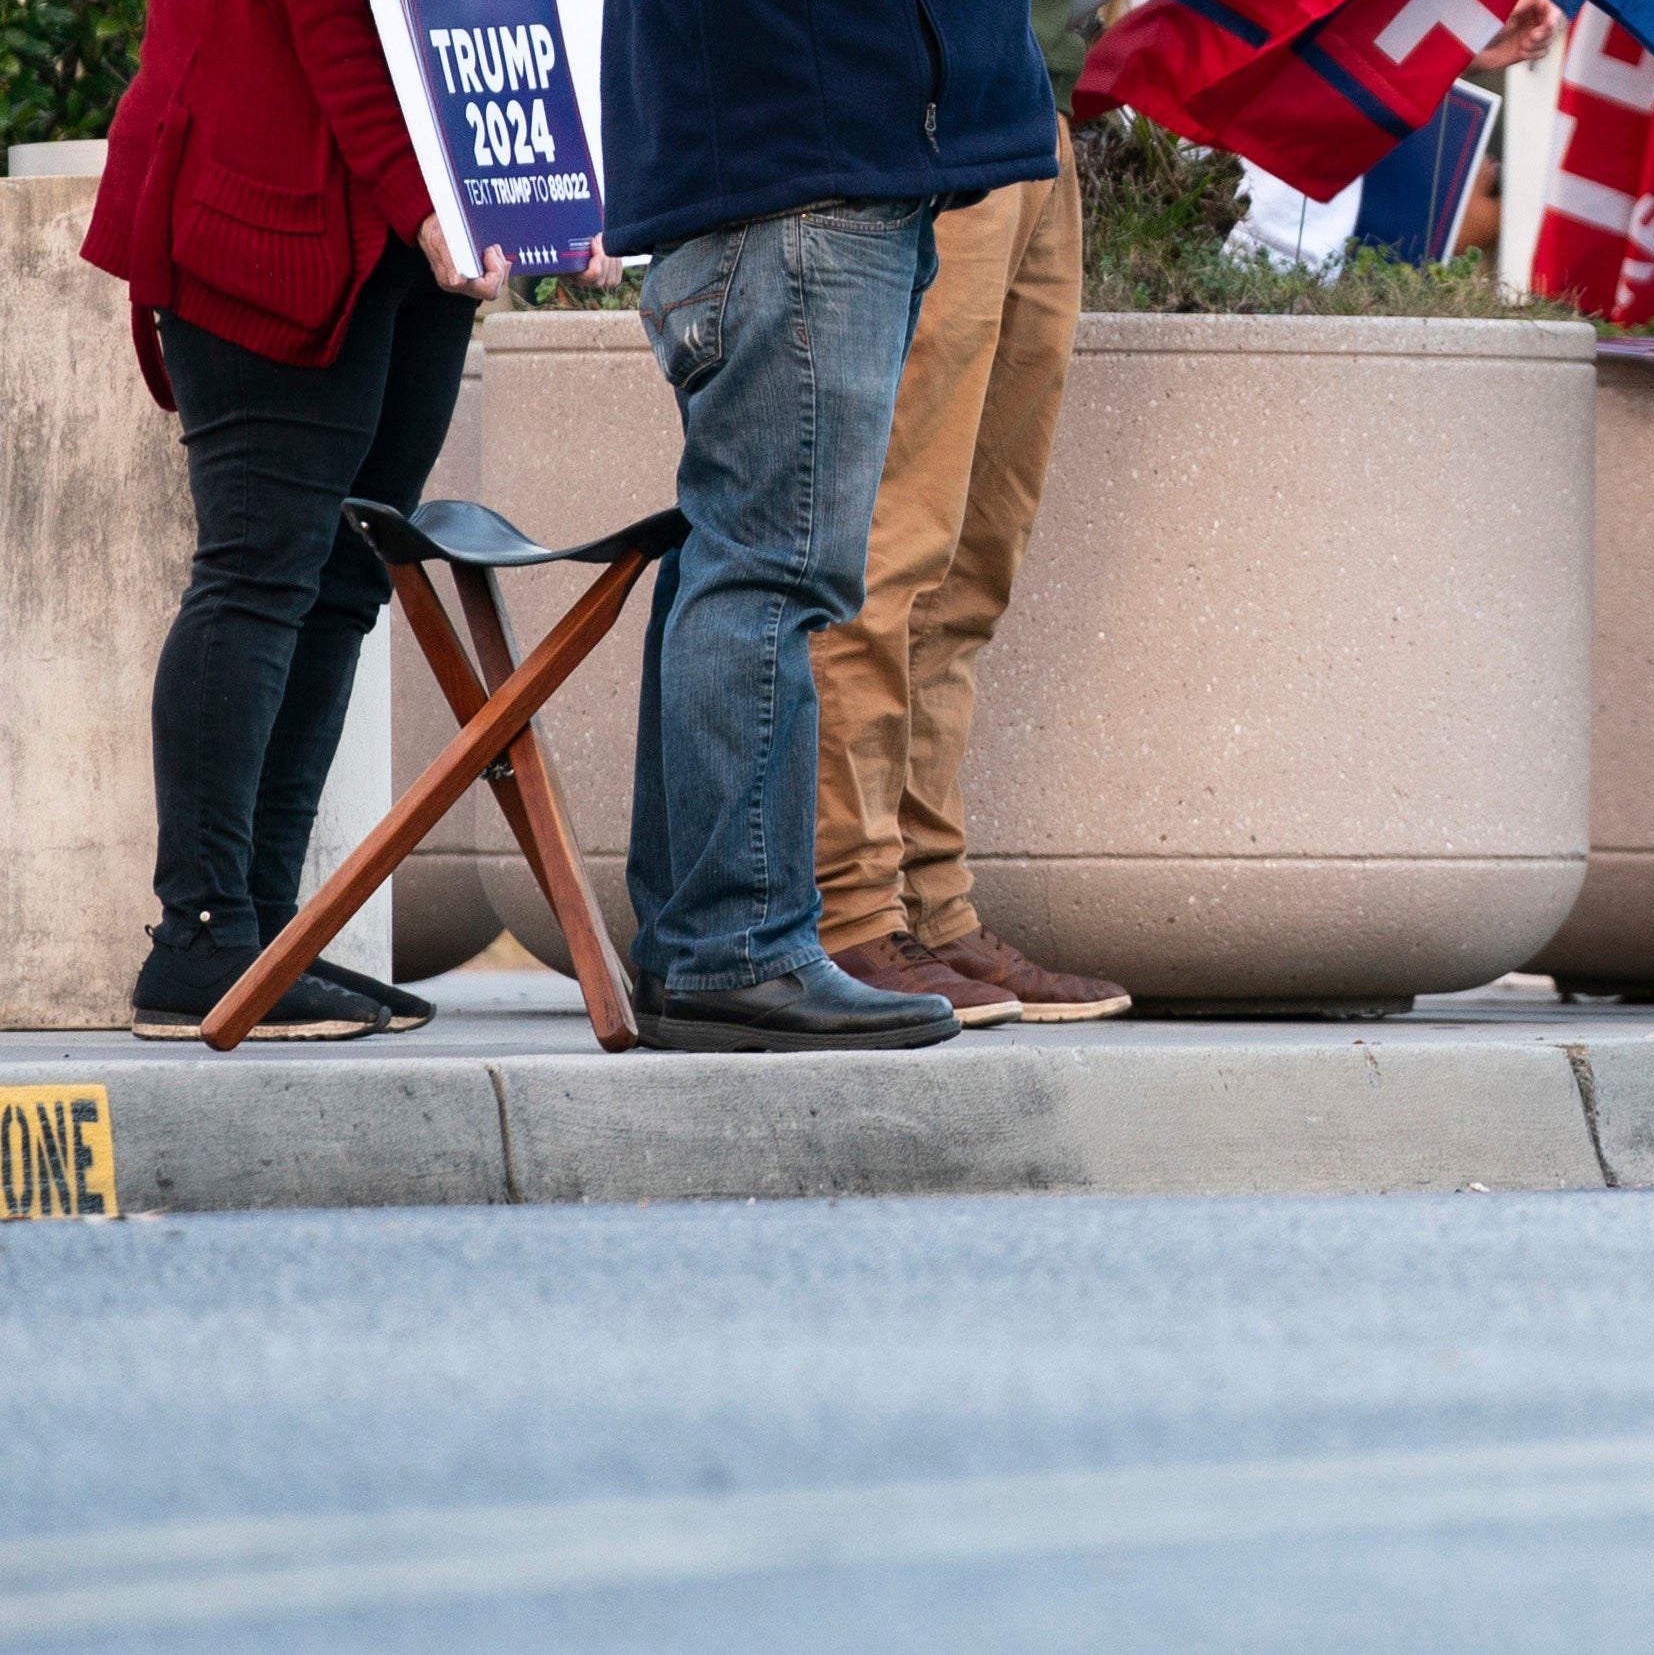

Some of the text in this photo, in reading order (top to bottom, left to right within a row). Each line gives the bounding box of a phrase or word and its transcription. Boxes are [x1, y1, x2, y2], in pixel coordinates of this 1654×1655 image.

[429, 24, 556, 94] TRUMP
[465, 98, 556, 167] 2024
[464, 172, 591, 205] TEXT TRUMP TO 88022
[0, 1099, 106, 1216] ONE
